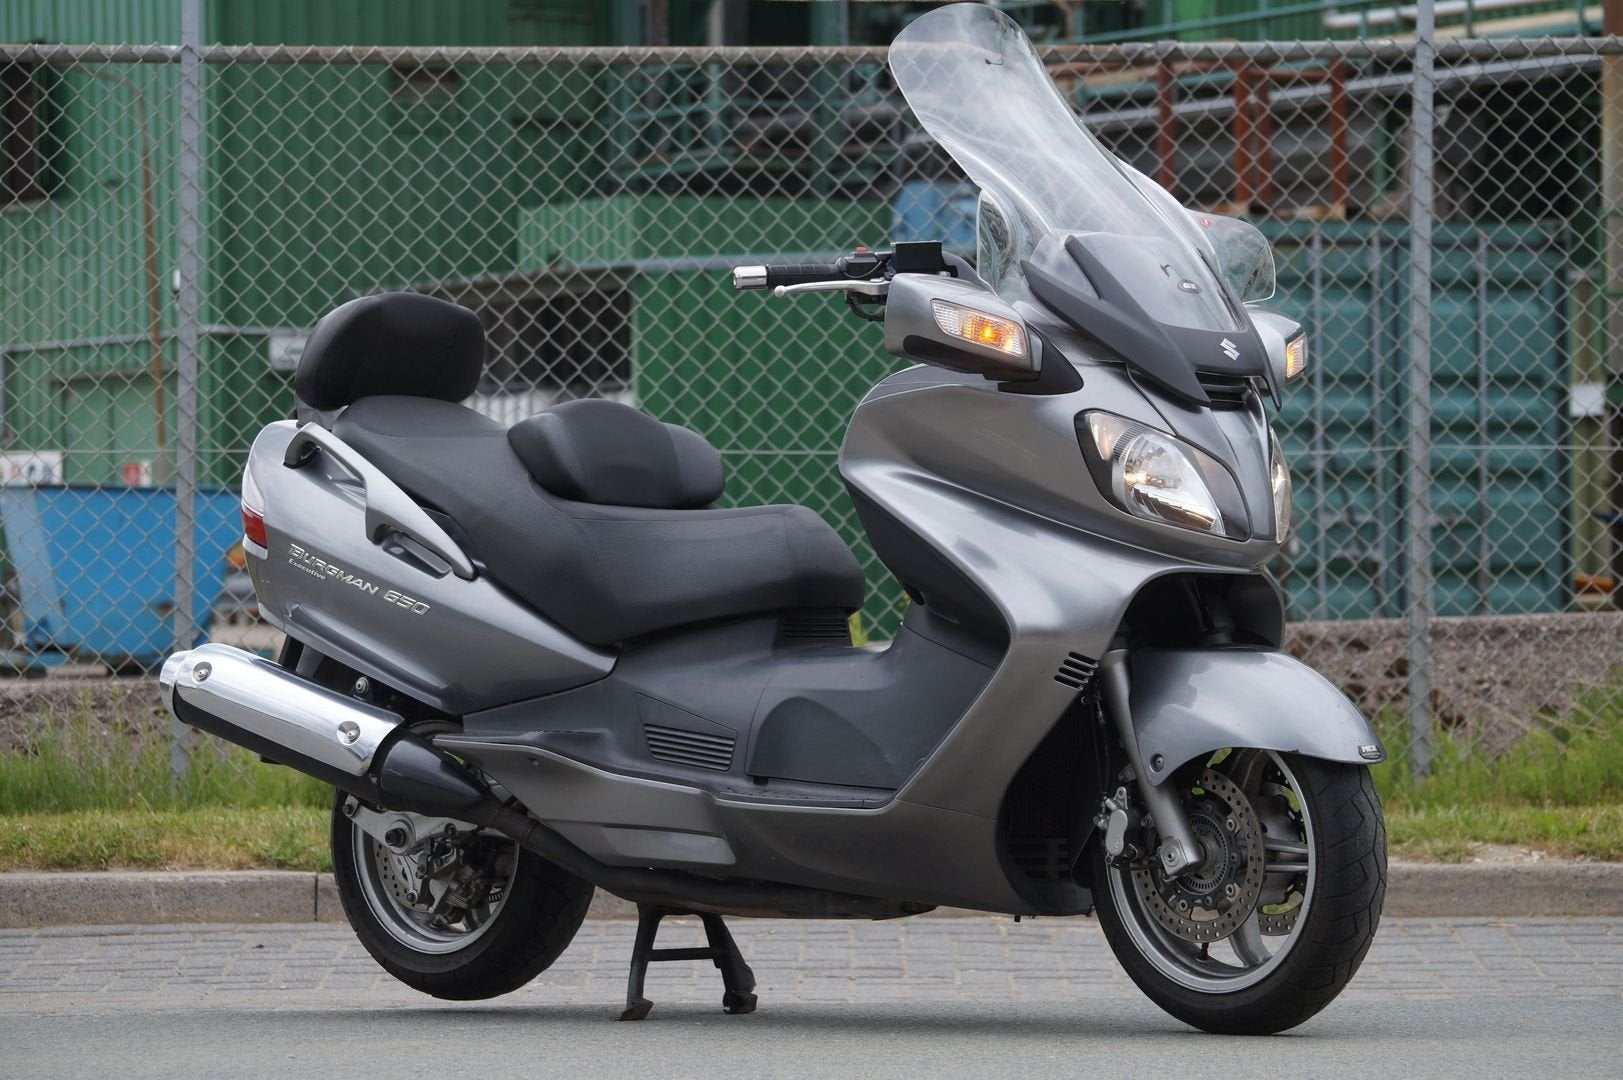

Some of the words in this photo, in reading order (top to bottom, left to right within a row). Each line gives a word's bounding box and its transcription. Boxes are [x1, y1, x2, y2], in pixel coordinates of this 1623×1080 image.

[288, 557, 327, 581] Executive
[289, 543, 379, 596] BURGMAN
[384, 589, 431, 616] 650
